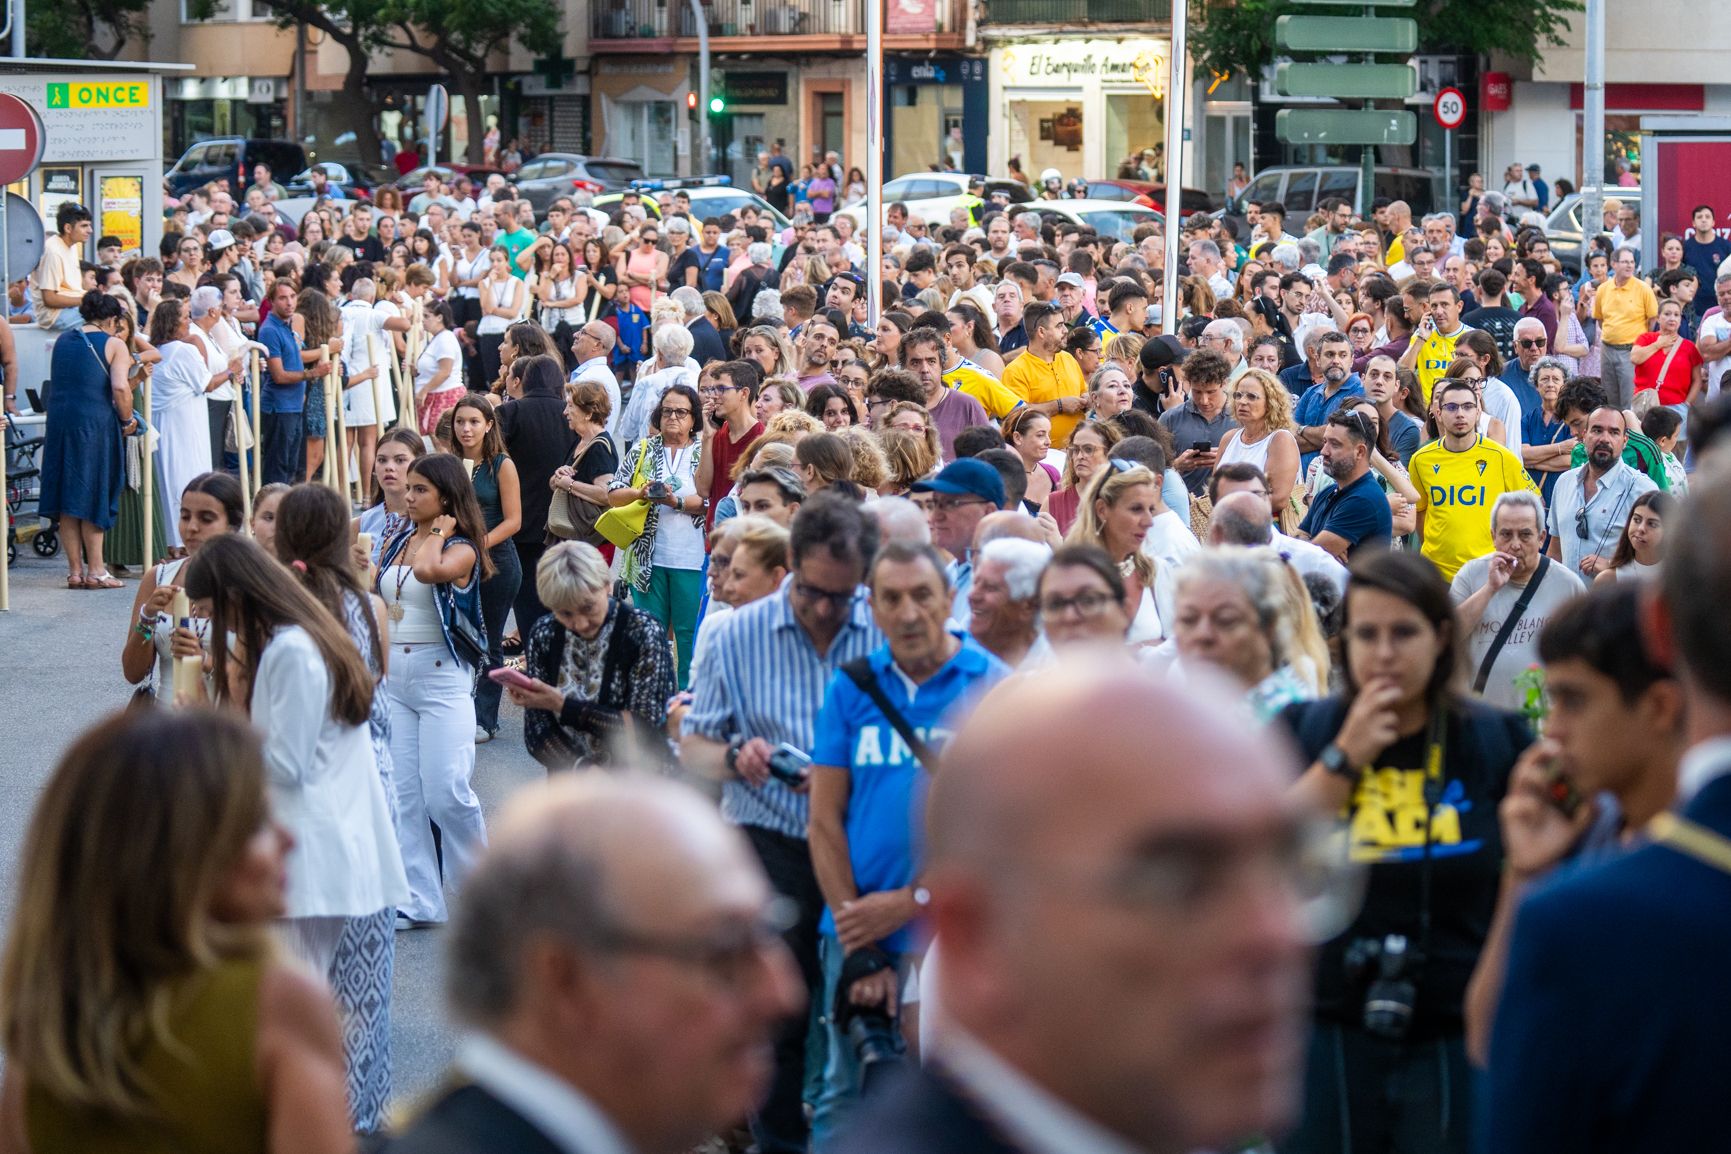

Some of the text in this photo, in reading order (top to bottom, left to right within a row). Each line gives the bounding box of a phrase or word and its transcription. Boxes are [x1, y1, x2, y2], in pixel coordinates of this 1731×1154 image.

[78, 86, 140, 104] ONCE
[1442, 101, 1459, 114] 50
[1426, 359, 1453, 369] DI
[1430, 485, 1485, 506] DIGI
[1496, 631, 1535, 645] LLEY
